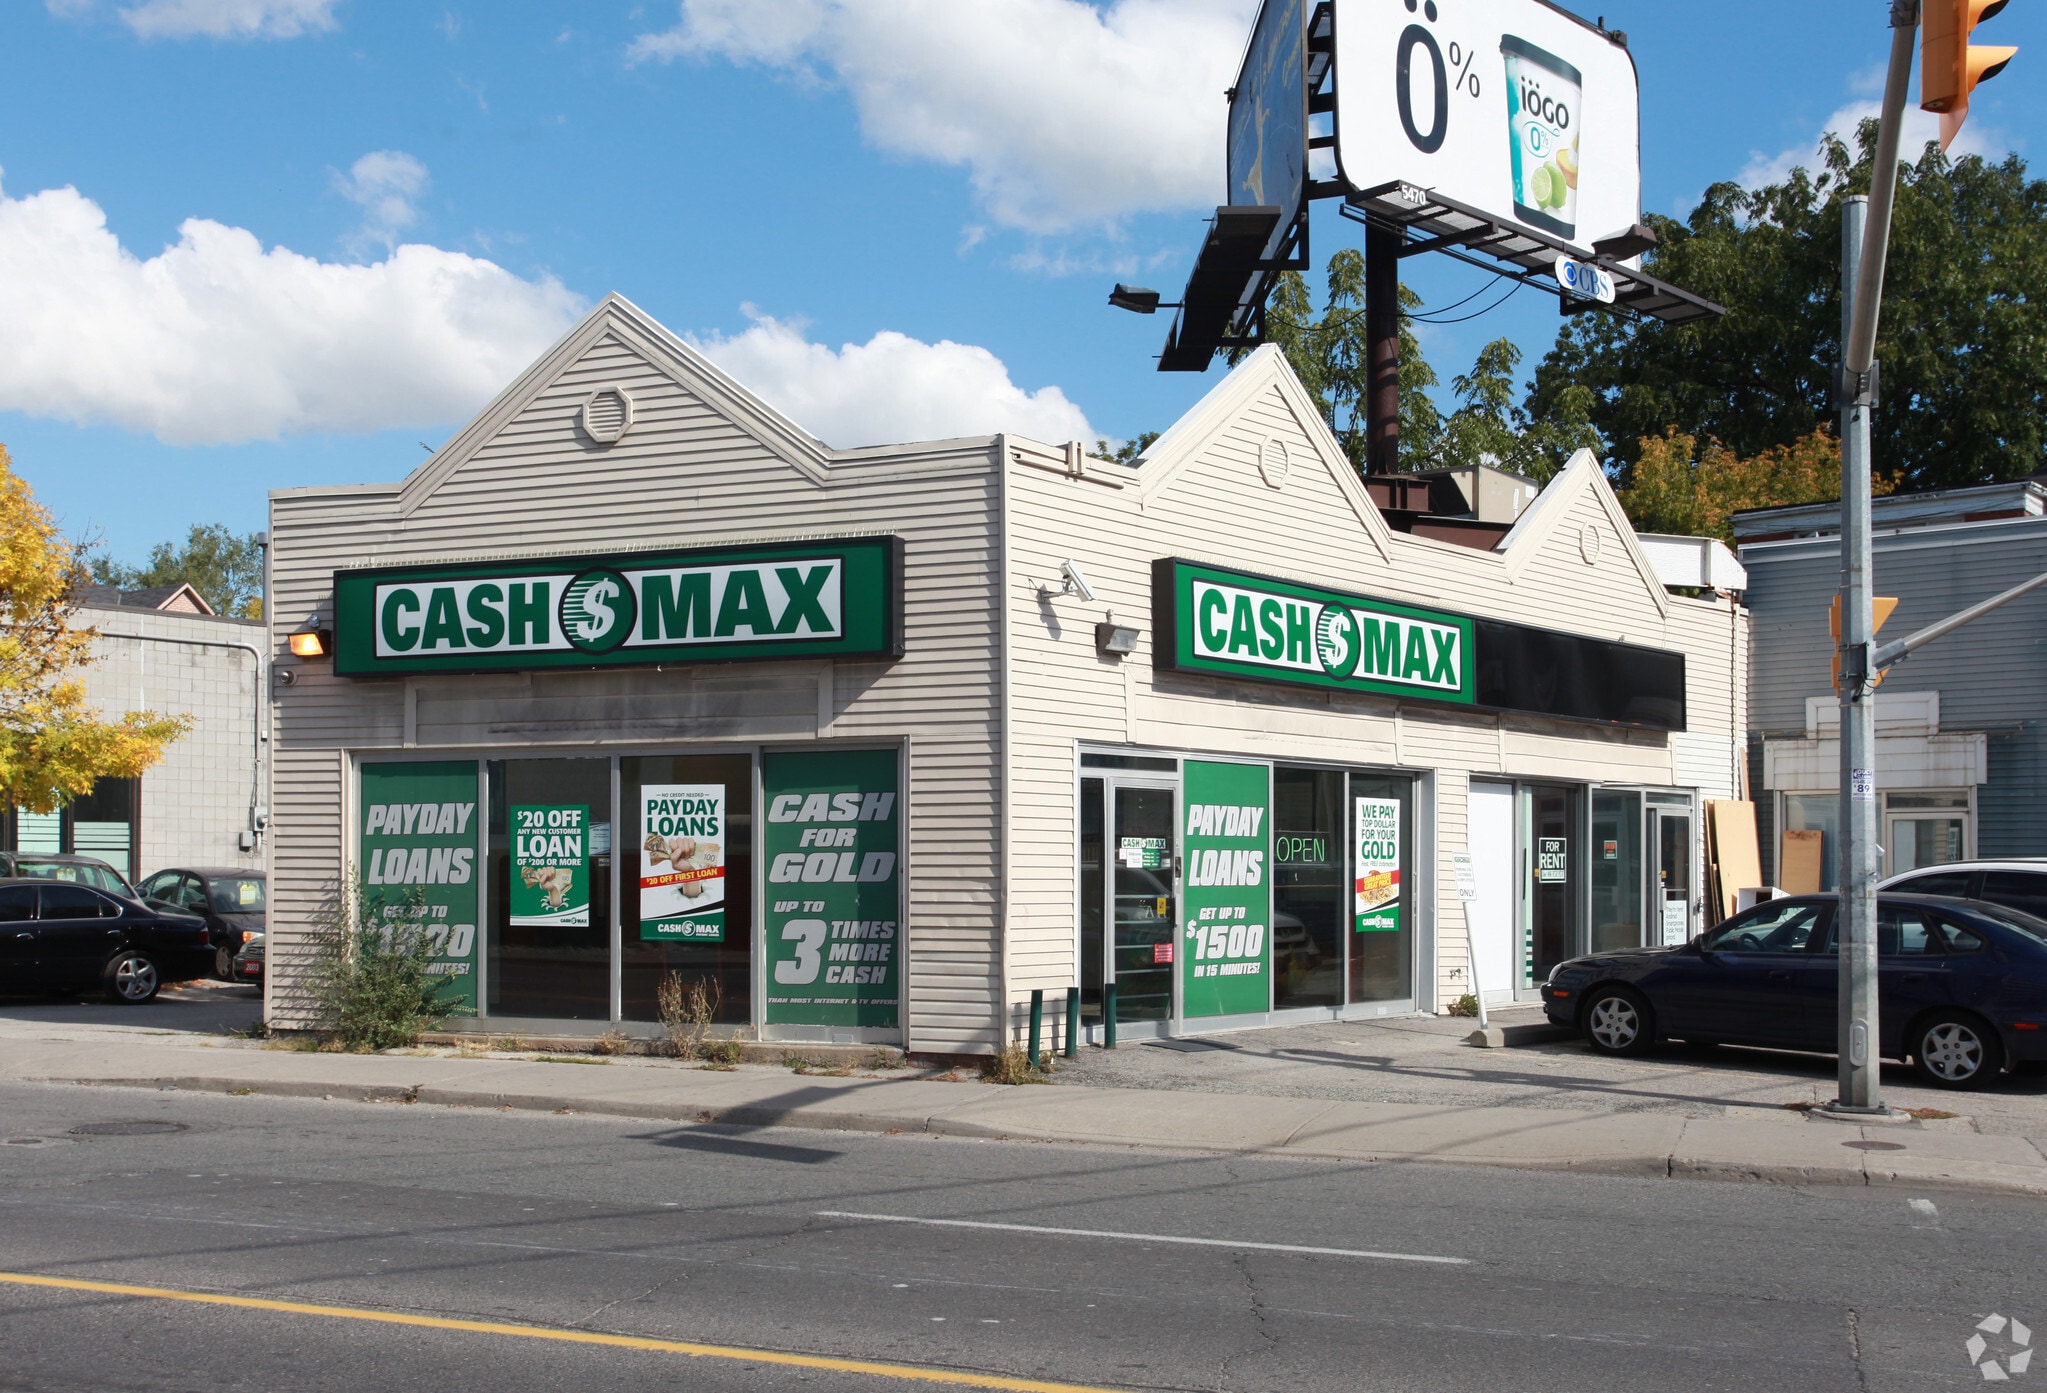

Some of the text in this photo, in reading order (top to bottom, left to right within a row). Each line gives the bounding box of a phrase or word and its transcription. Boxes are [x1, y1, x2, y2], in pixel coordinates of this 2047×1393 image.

[1401, 184, 1427, 206] 5470
[1579, 267, 1608, 298] CBS
[381, 581, 550, 653] CASH
[642, 565, 835, 640] MAX
[1199, 588, 1311, 664] CASH
[1363, 616, 1458, 686] MAX
[647, 799, 719, 815] PAYDAY
[767, 792, 896, 823] CASH
[1362, 804, 1396, 819] WE PAY
[366, 803, 475, 835] PAYDAY
[517, 810, 581, 827] $20 OFF
[647, 816, 719, 837] LOANS
[1187, 804, 1264, 837] PAYDAY
[1362, 819, 1396, 829] TOP DOLLAR
[799, 828, 857, 848] FOR
[1123, 838, 1165, 848] CASH MAX
[1362, 829, 1396, 840] FOR YOUR
[517, 835, 582, 858] LOAN
[1276, 837, 1325, 862] OPEN
[1362, 841, 1396, 860] GOLD
[1545, 841, 1560, 852] FOR
[368, 848, 474, 885] LOANS
[517, 858, 527, 866] OF
[546, 858, 557, 866] OR
[559, 858, 582, 866] MORE
[768, 852, 896, 883] GOLD
[1188, 850, 1263, 886] LOANS
[1540, 853, 1565, 868] RENT
[675, 871, 695, 881] FIRST
[697, 868, 718, 878] LOAN
[1460, 889, 1475, 897] ONLY
[432, 905, 448, 918] TO
[773, 901, 825, 913] UP TO
[1199, 906, 1246, 920] GET UP TO
[657, 923, 682, 933] CASH
[696, 924, 720, 933] MAX
[830, 921, 896, 939] TIMES
[1186, 919, 1264, 960] $1500
[774, 919, 828, 985] 3
[828, 943, 892, 962] MORE
[825, 965, 887, 984] CASH
[1194, 962, 1261, 978] IN 15 MINUTES!
